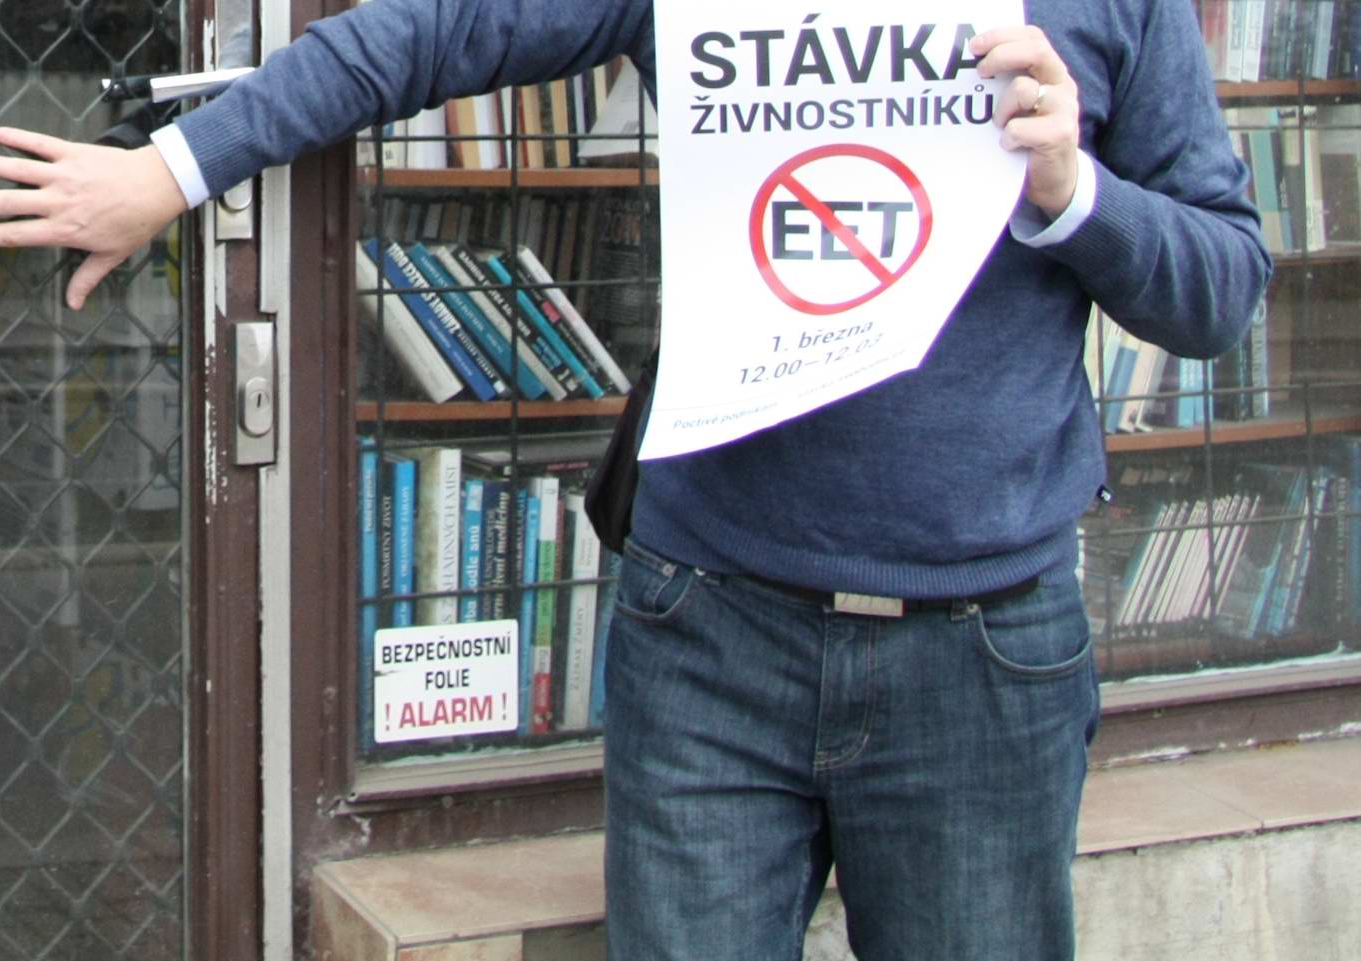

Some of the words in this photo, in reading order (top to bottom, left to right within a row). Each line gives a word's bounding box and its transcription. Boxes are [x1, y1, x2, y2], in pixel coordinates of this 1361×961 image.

[690, 13, 995, 89] STÁVKA
[691, 84, 994, 134] ŽIVNOSTNÍKŮ
[771, 201, 913, 261] EET
[771, 335, 789, 353] 1.
[798, 320, 874, 348] března
[382, 632, 511, 664] BEZPEČNOSTNÍ
[425, 669, 470, 690] FOLIE
[399, 695, 493, 729] ALARM
